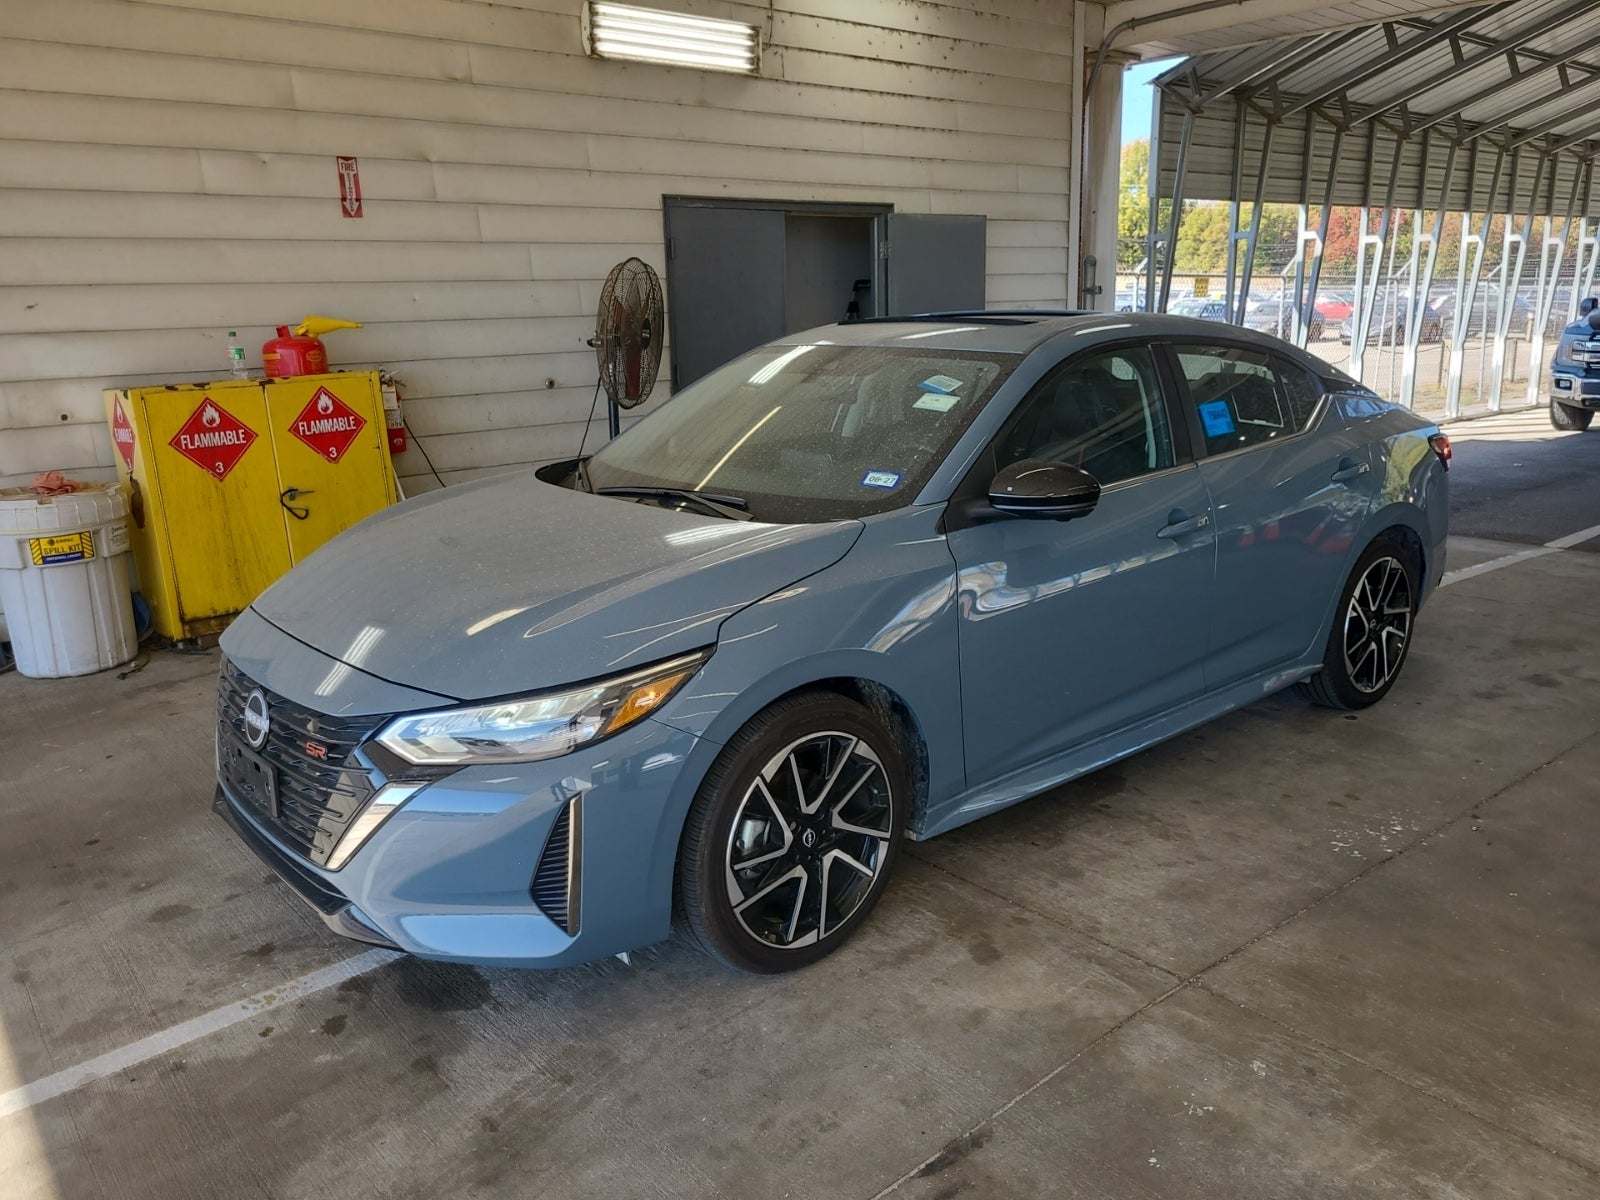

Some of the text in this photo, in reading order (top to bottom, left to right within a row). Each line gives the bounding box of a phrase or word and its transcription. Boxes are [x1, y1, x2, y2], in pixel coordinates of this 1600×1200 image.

[340, 162, 355, 172] FIRE
[298, 415, 357, 436] FLAMMABLE
[180, 429, 247, 450] FLAMMABLE
[329, 446, 337, 458] 3
[215, 461, 224, 473] 3
[43, 543, 81, 556] SPILL KIT
[306, 741, 327, 760] SR
